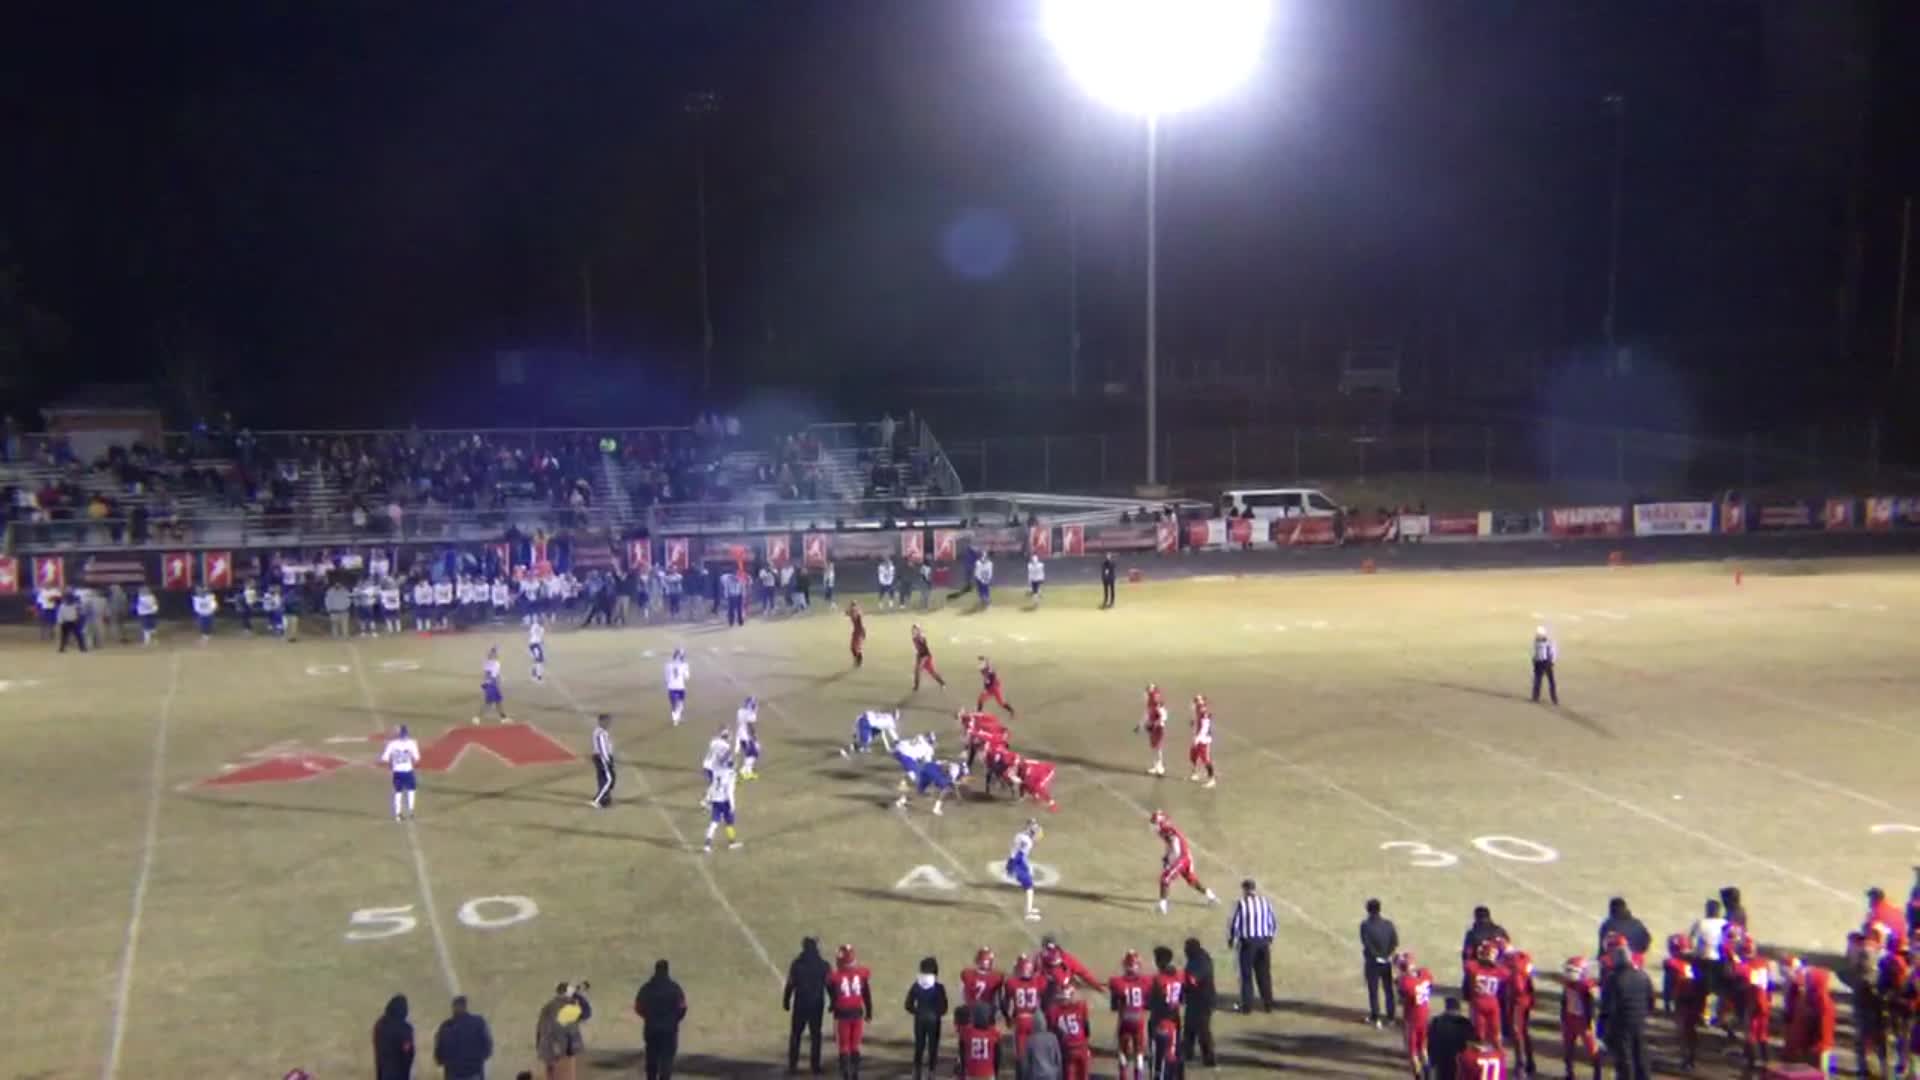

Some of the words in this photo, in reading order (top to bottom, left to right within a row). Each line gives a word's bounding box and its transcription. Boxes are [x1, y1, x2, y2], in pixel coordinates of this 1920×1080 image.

[1379, 835, 1558, 868] 30
[345, 895, 539, 940] 50
[840, 975, 861, 997] 44
[975, 981, 986, 1000] 7
[1475, 974, 1499, 996] 50
[1015, 987, 1037, 1008] 83
[971, 1037, 989, 1060] 21
[1477, 1057, 1501, 1080] 77
